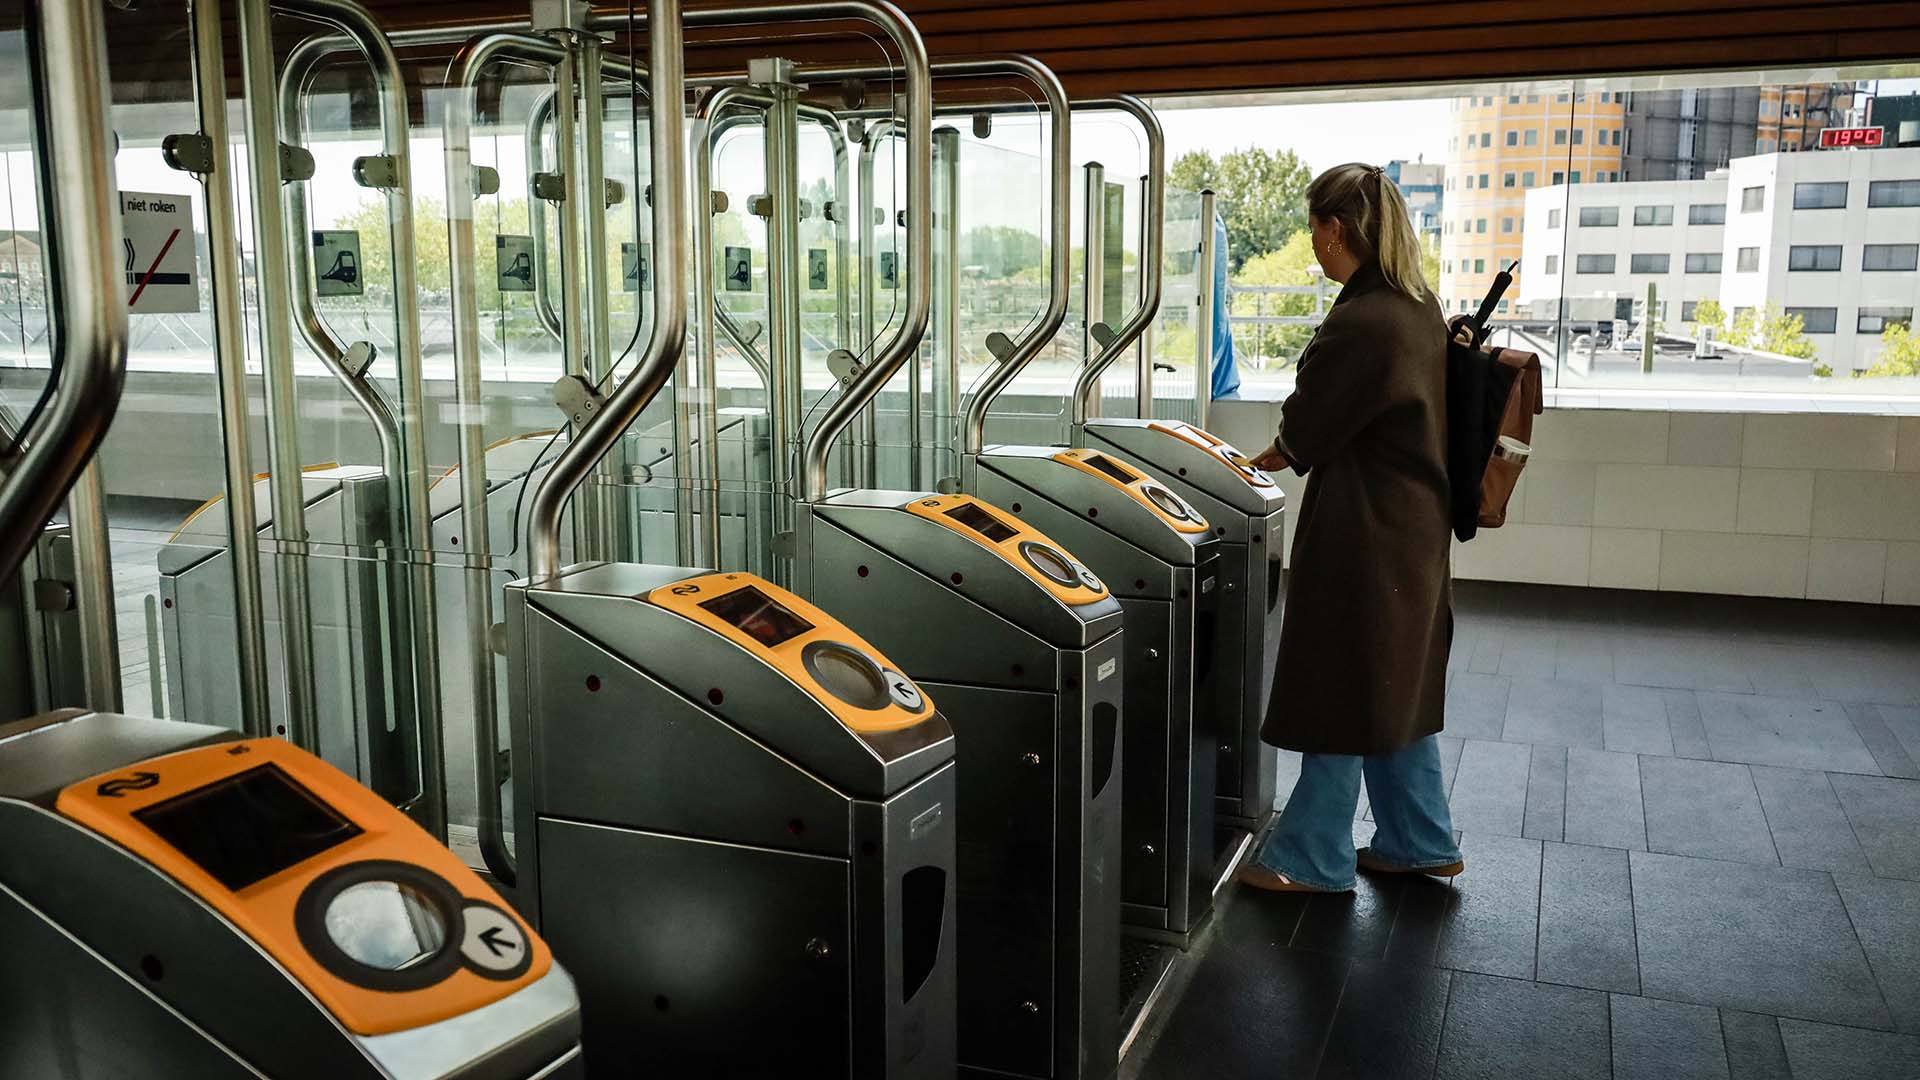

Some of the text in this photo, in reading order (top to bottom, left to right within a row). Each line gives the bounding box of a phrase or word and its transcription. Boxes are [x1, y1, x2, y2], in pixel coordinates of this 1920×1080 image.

[1833, 129, 1876, 145] 19°C
[127, 198, 177, 214] niet roken
